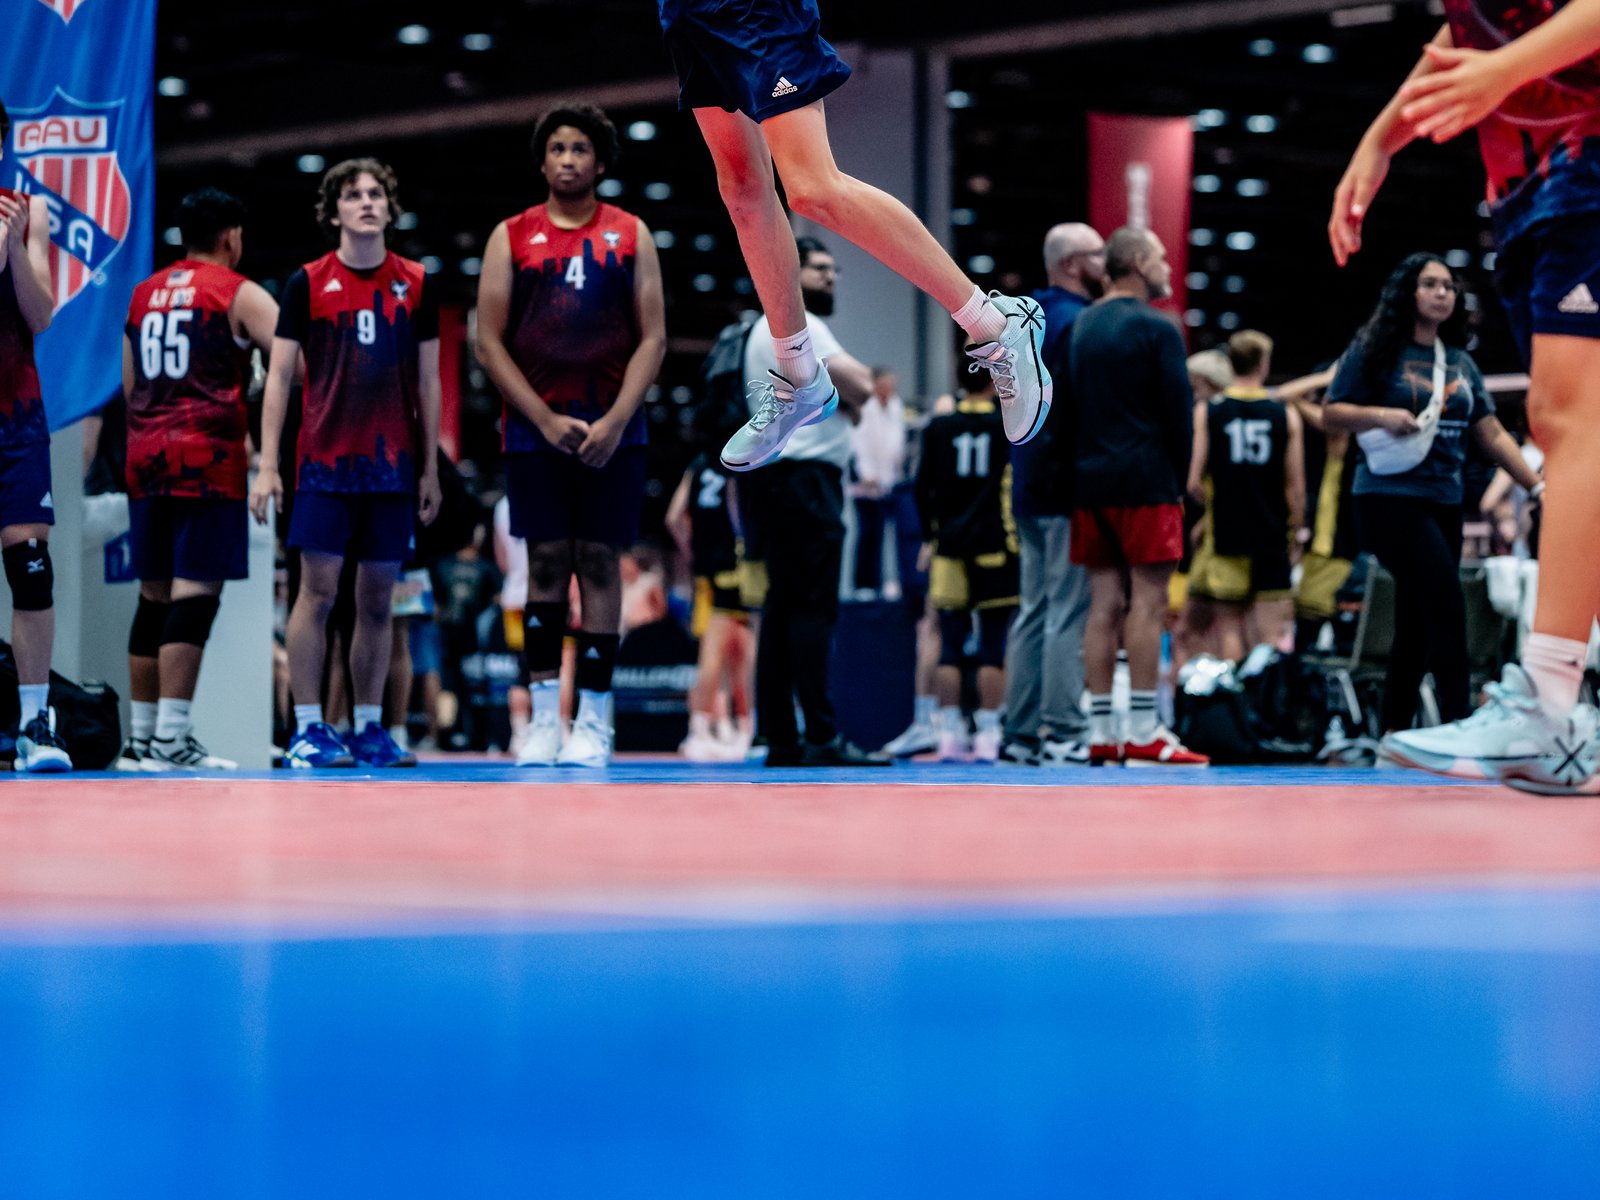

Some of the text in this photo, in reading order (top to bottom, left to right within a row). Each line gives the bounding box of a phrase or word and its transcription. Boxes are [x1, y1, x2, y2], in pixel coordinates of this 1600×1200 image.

[772, 85, 798, 98] adidas
[19, 116, 99, 147] AAU
[565, 255, 587, 290] 4
[141, 310, 193, 380] 65
[357, 309, 376, 345] 9
[952, 431, 991, 478] 11
[1223, 417, 1272, 465] 15
